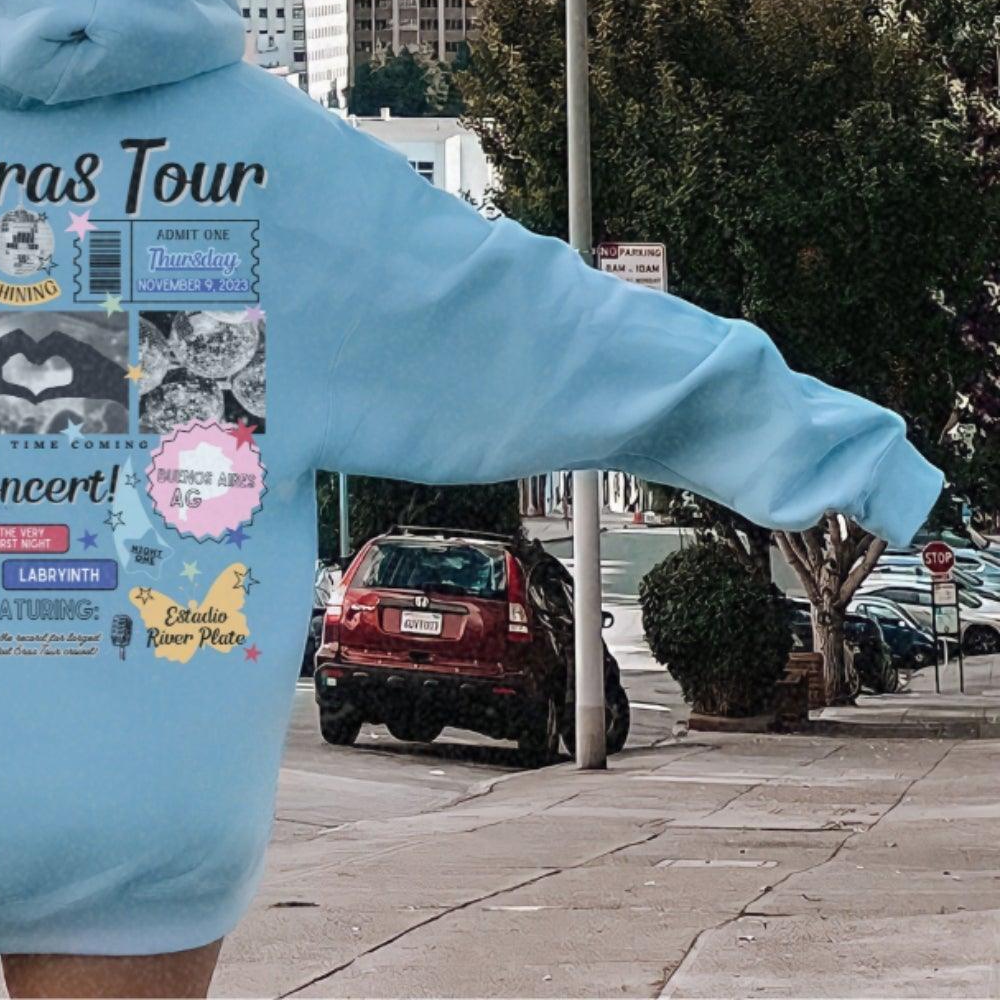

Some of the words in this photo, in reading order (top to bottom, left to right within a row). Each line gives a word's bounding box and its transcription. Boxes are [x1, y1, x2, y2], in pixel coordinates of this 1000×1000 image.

[120, 137, 267, 216] Tour
[157, 229, 199, 240] ADMIT
[204, 229, 230, 240] ONE
[600, 246, 617, 257] NO
[620, 248, 662, 257] PARKING
[147, 247, 238, 275] Thursday
[138, 279, 201, 292] NOVEMBER
[204, 279, 216, 293] 9,
[219, 279, 249, 292] 2023
[10, 440, 59, 450] TIME
[71, 440, 149, 450] COMING
[0, 528, 16, 538] THE
[20, 528, 45, 538] VERY
[21, 539, 52, 549] NIGHT
[925, 551, 953, 565] STOP
[18, 567, 101, 583] LABRYINTH
[164, 605, 228, 627] Estadio
[146, 626, 194, 648] River
[199, 626, 247, 648] Plate
